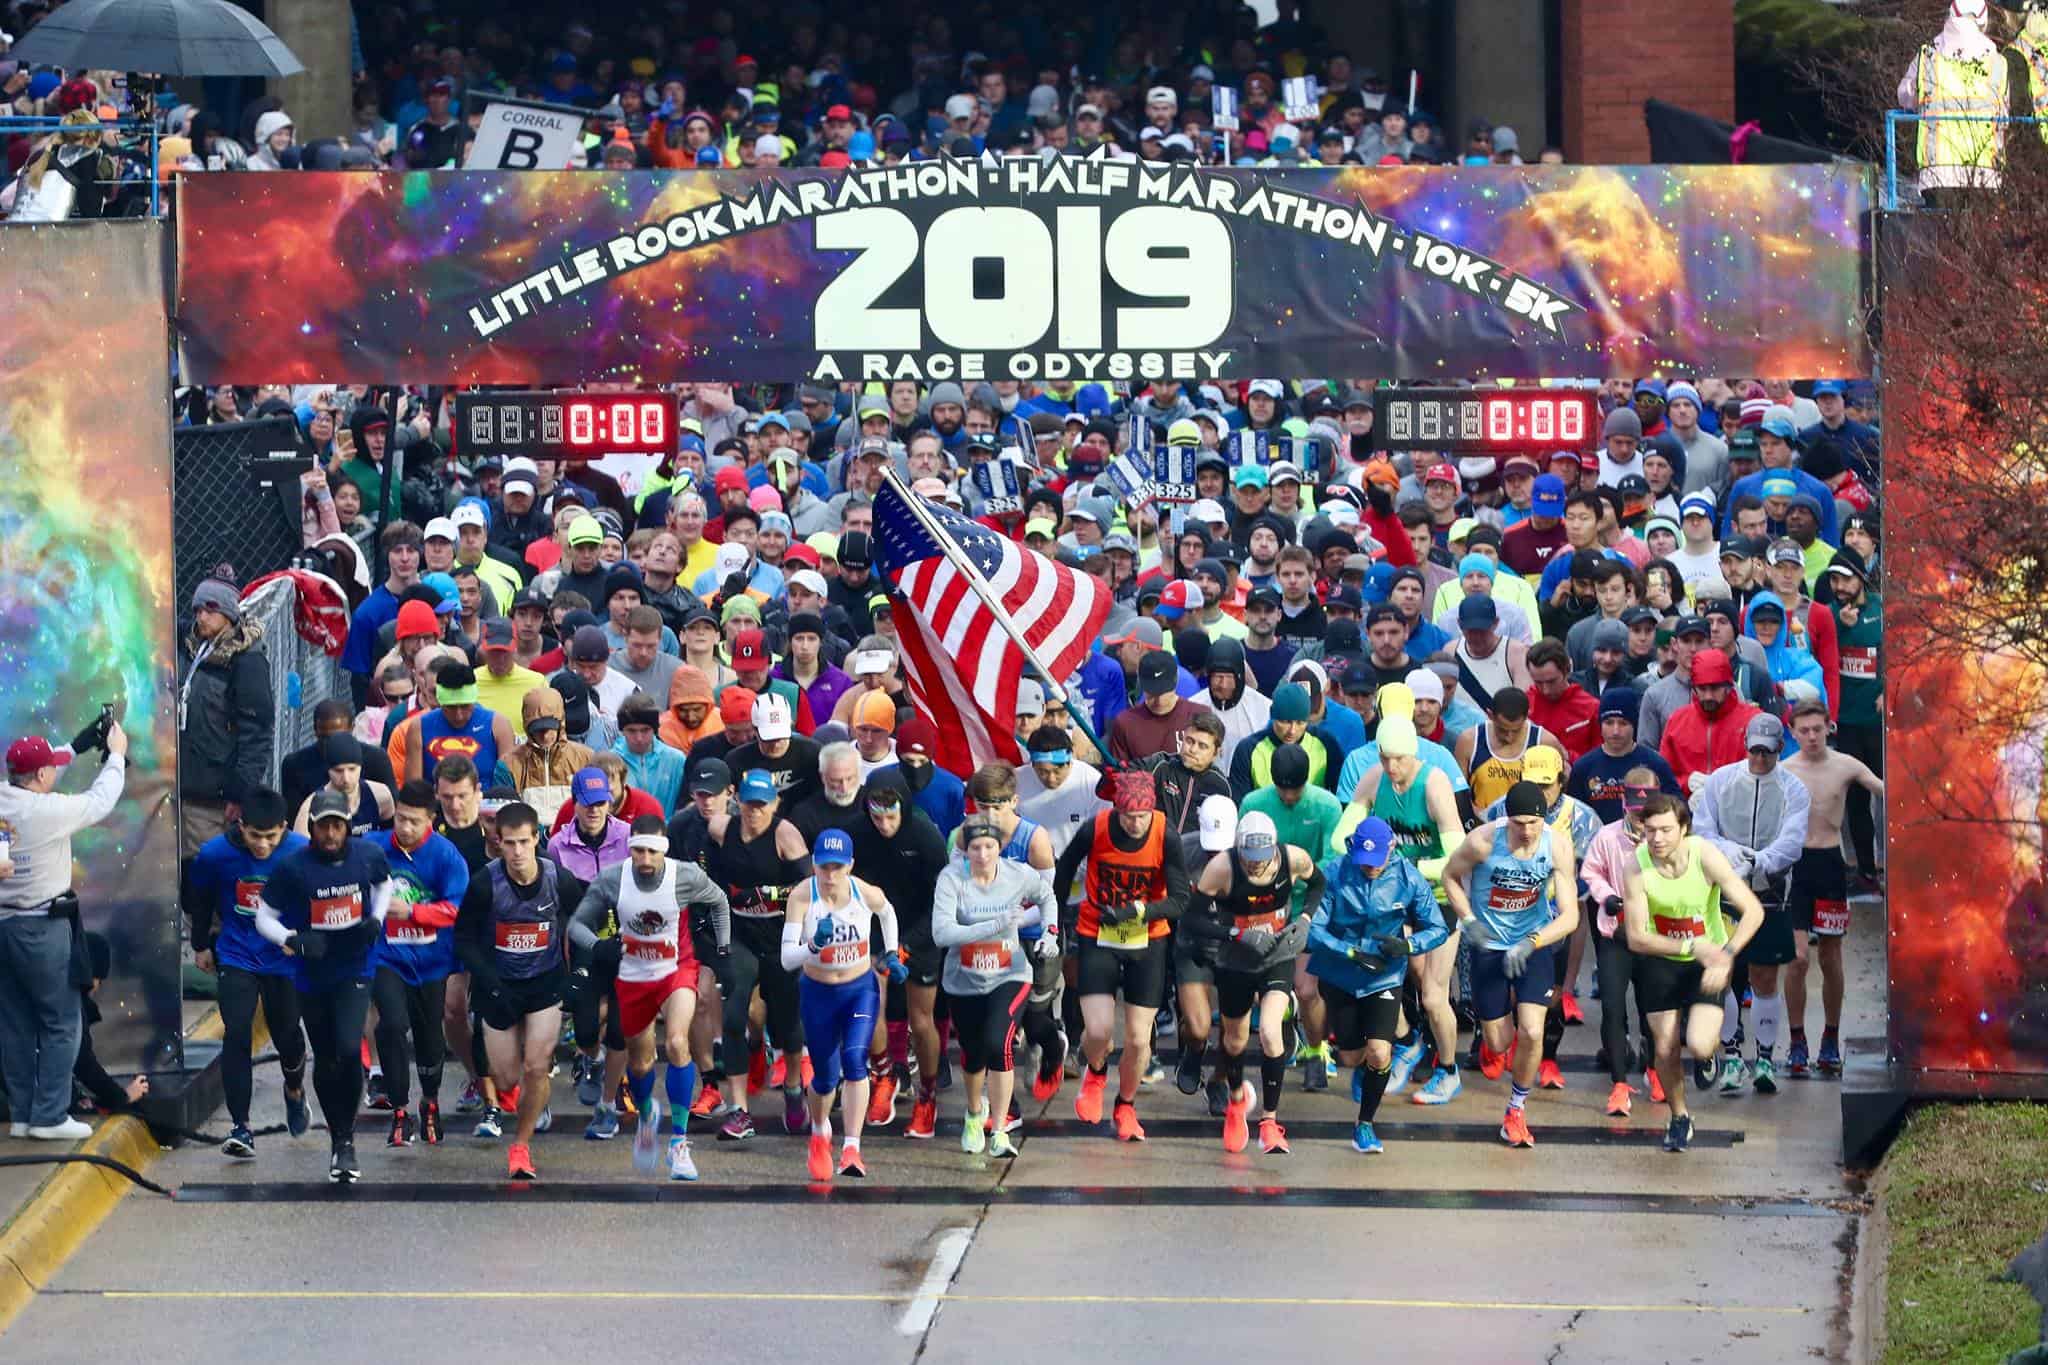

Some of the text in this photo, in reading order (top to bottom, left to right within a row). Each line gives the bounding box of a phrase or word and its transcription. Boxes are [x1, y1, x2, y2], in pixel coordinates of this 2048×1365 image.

[501, 110, 565, 132] CORRAL
[497, 128, 544, 170] B
[469, 161, 1570, 337] LITTLE ROCK MARATHON HALF MARATHON 10K 5K
[814, 205, 1233, 351] 2019
[813, 352, 1232, 380] A RACE ODYSSEY
[1159, 486, 1192, 499] 3:25
[986, 495, 1019, 513] 3:25
[1488, 766, 1521, 780] SPOKAN
[824, 837, 844, 851] USA
[1097, 866, 1152, 889] RUN
[509, 940, 537, 949] 3002
